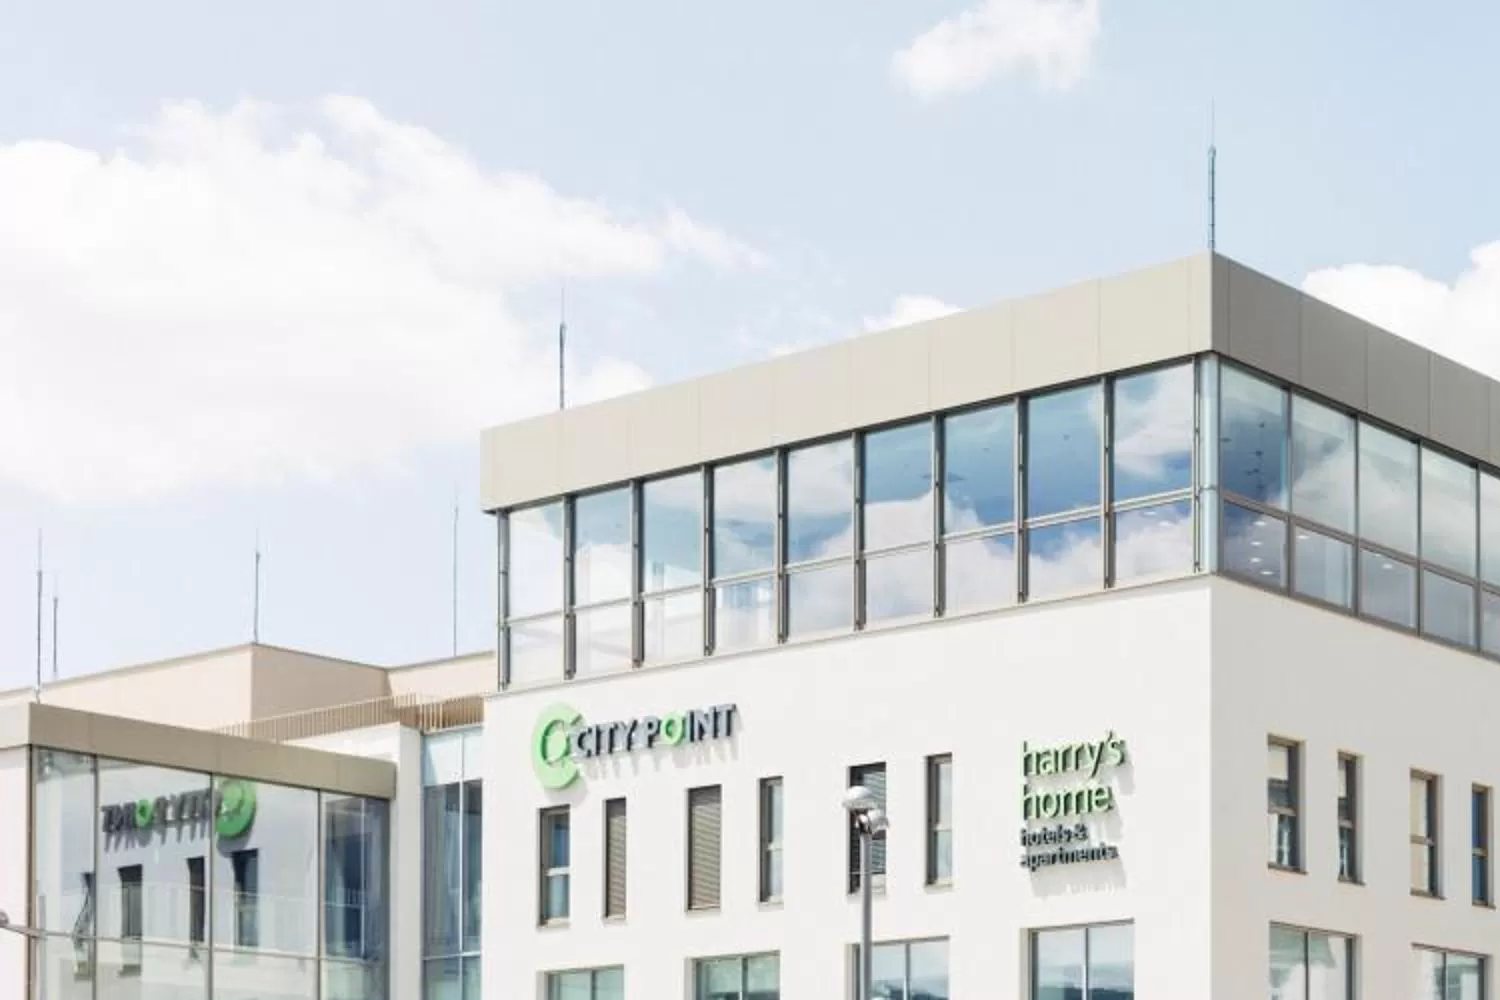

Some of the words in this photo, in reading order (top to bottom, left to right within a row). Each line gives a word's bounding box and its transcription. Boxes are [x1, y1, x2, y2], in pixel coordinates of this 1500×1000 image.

[1018, 730, 1126, 778] harry's
[1018, 784, 1114, 820] home
[1020, 824, 1072, 847] hotels
[1019, 842, 1119, 872] apartments
